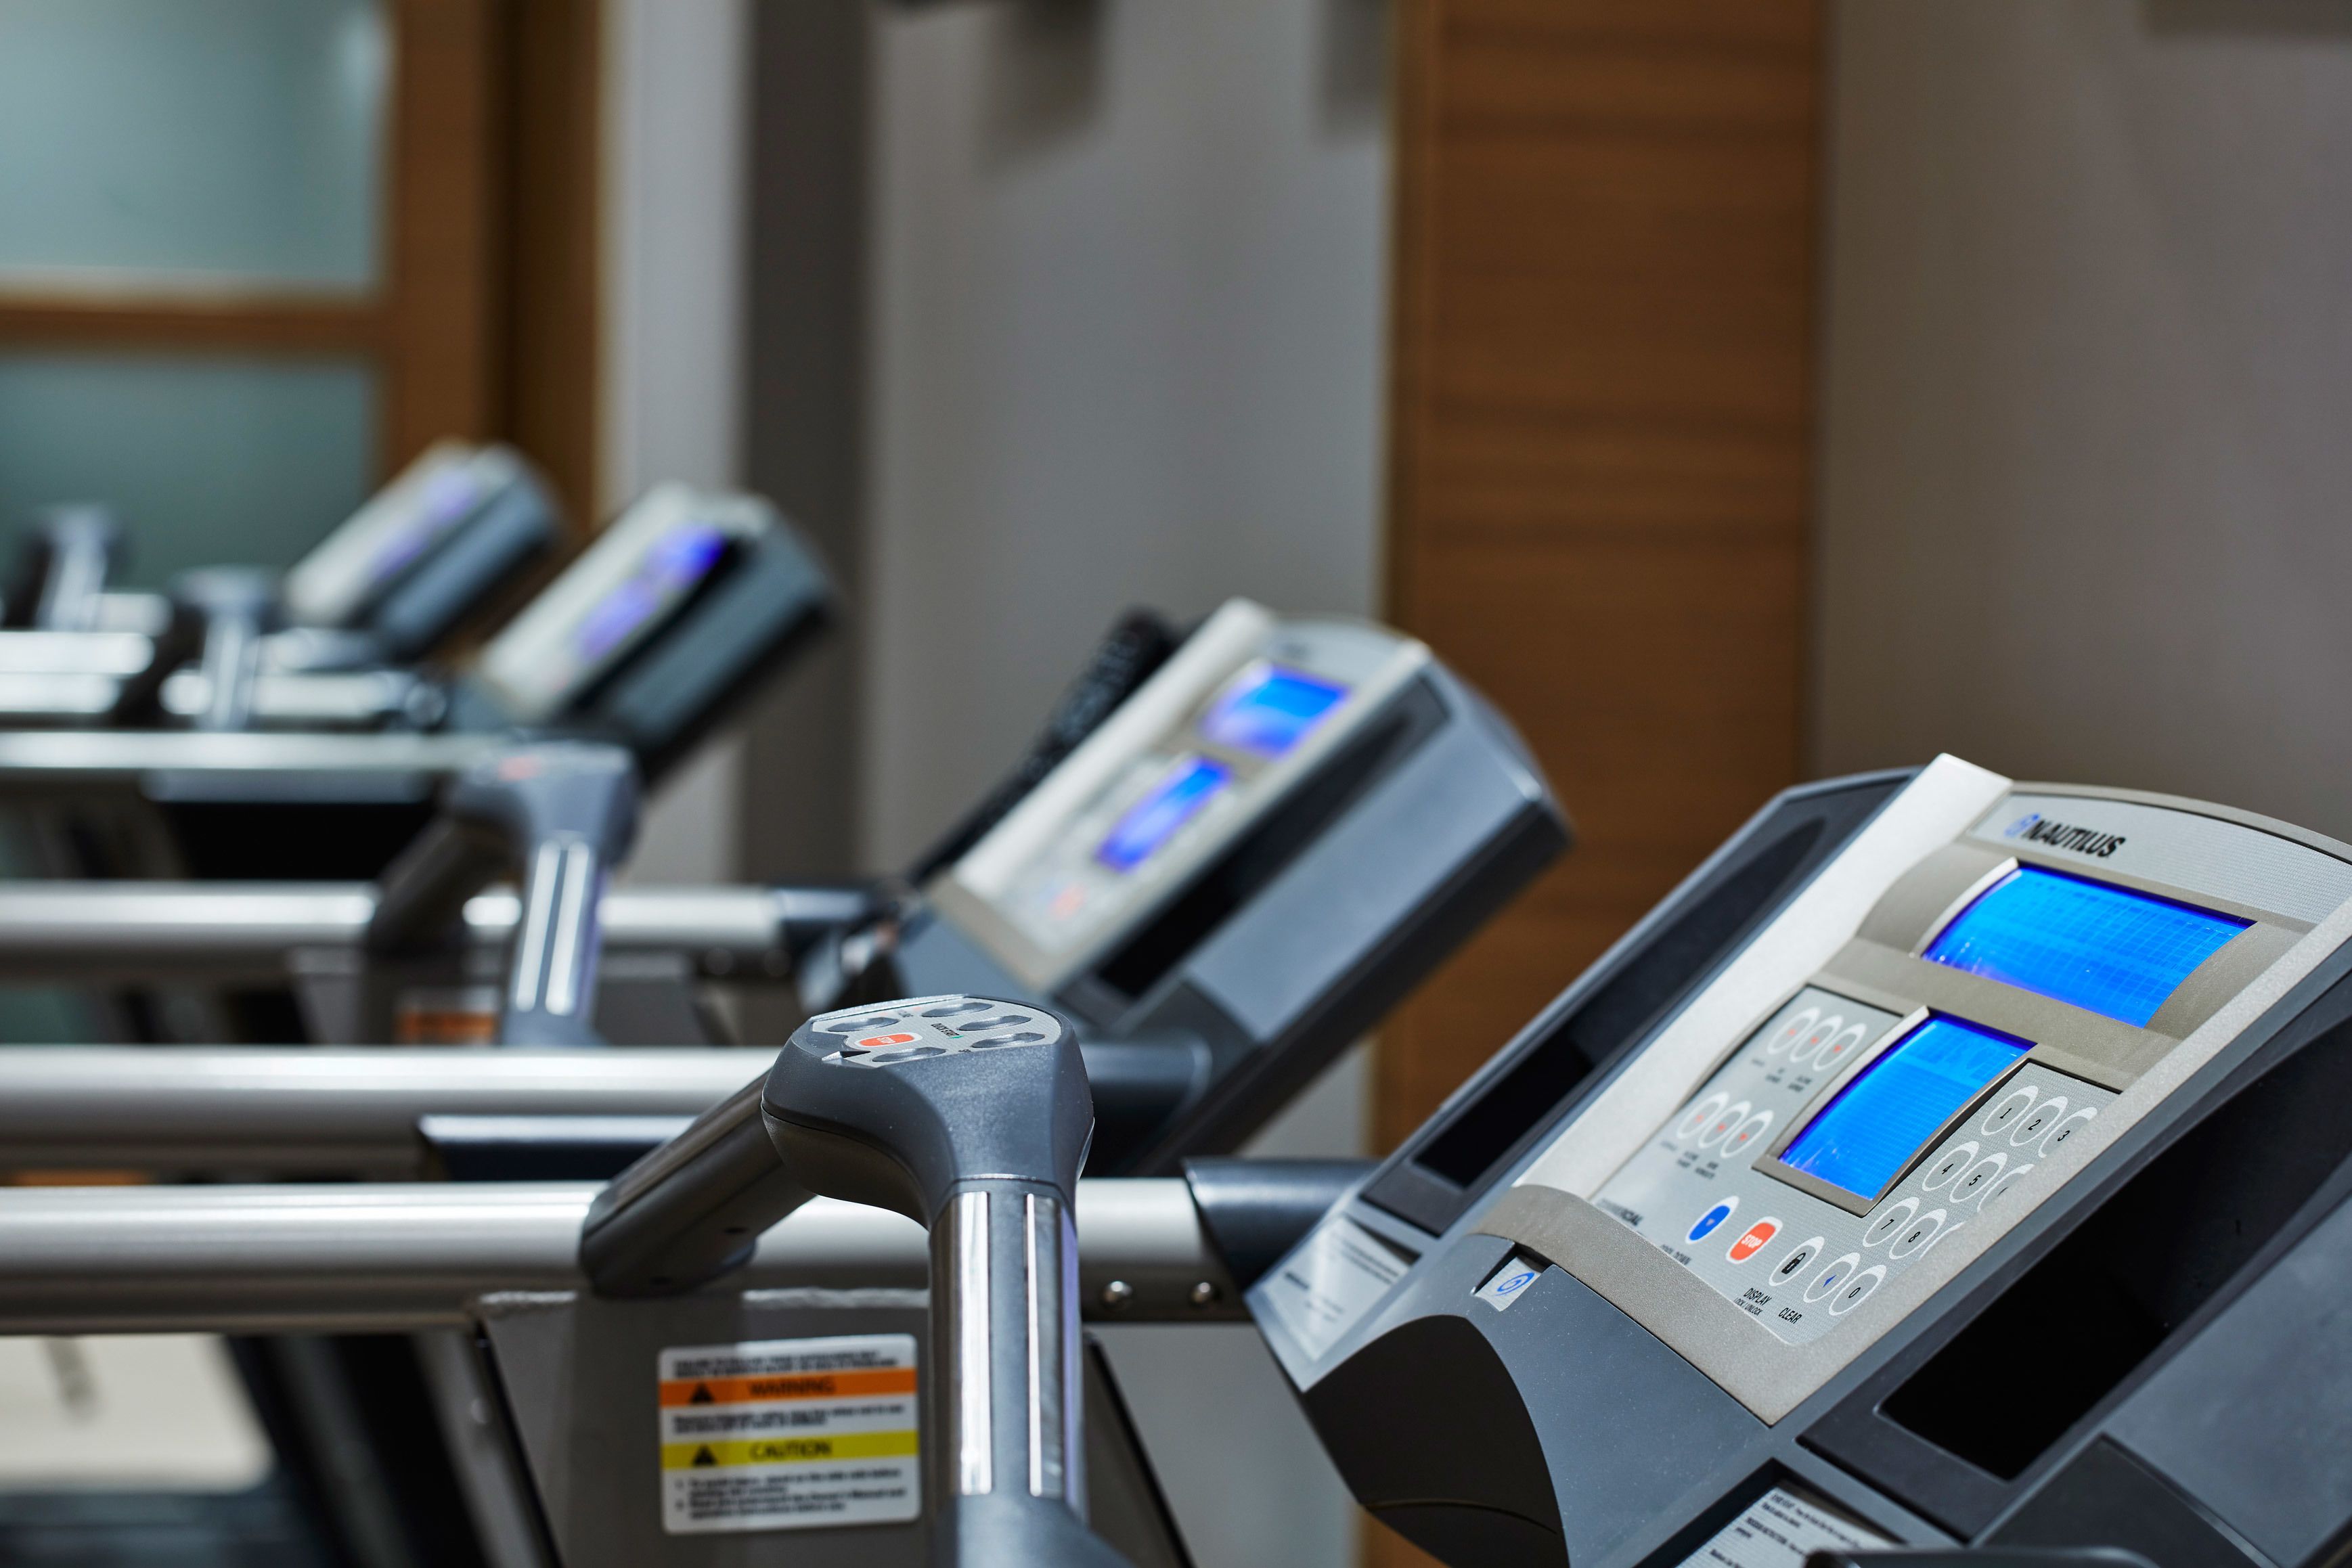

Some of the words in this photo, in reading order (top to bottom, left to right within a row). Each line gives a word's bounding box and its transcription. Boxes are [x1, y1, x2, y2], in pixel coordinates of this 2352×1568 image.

[2022, 819, 2126, 857] NAUTILUS
[1999, 1108, 2012, 1119] 1
[2027, 1119, 2042, 1131] 2
[2057, 1129, 2070, 1142] 3
[1941, 1163, 1954, 1175] 4
[1968, 1174, 1982, 1186] 5
[1880, 1218, 1895, 1230] 7
[1741, 1234, 1763, 1249] STOP
[1907, 1231, 1921, 1243] 8
[1743, 1287, 1773, 1306] DISPLAY
[1848, 1287, 1861, 1299] 0
[1733, 1297, 1746, 1307] LOCK
[1744, 1303, 1764, 1316] UNLOCK
[1778, 1307, 1802, 1324] CLEAR
[749, 1376, 837, 1397] WARNING
[750, 1440, 833, 1460] CAUTION
